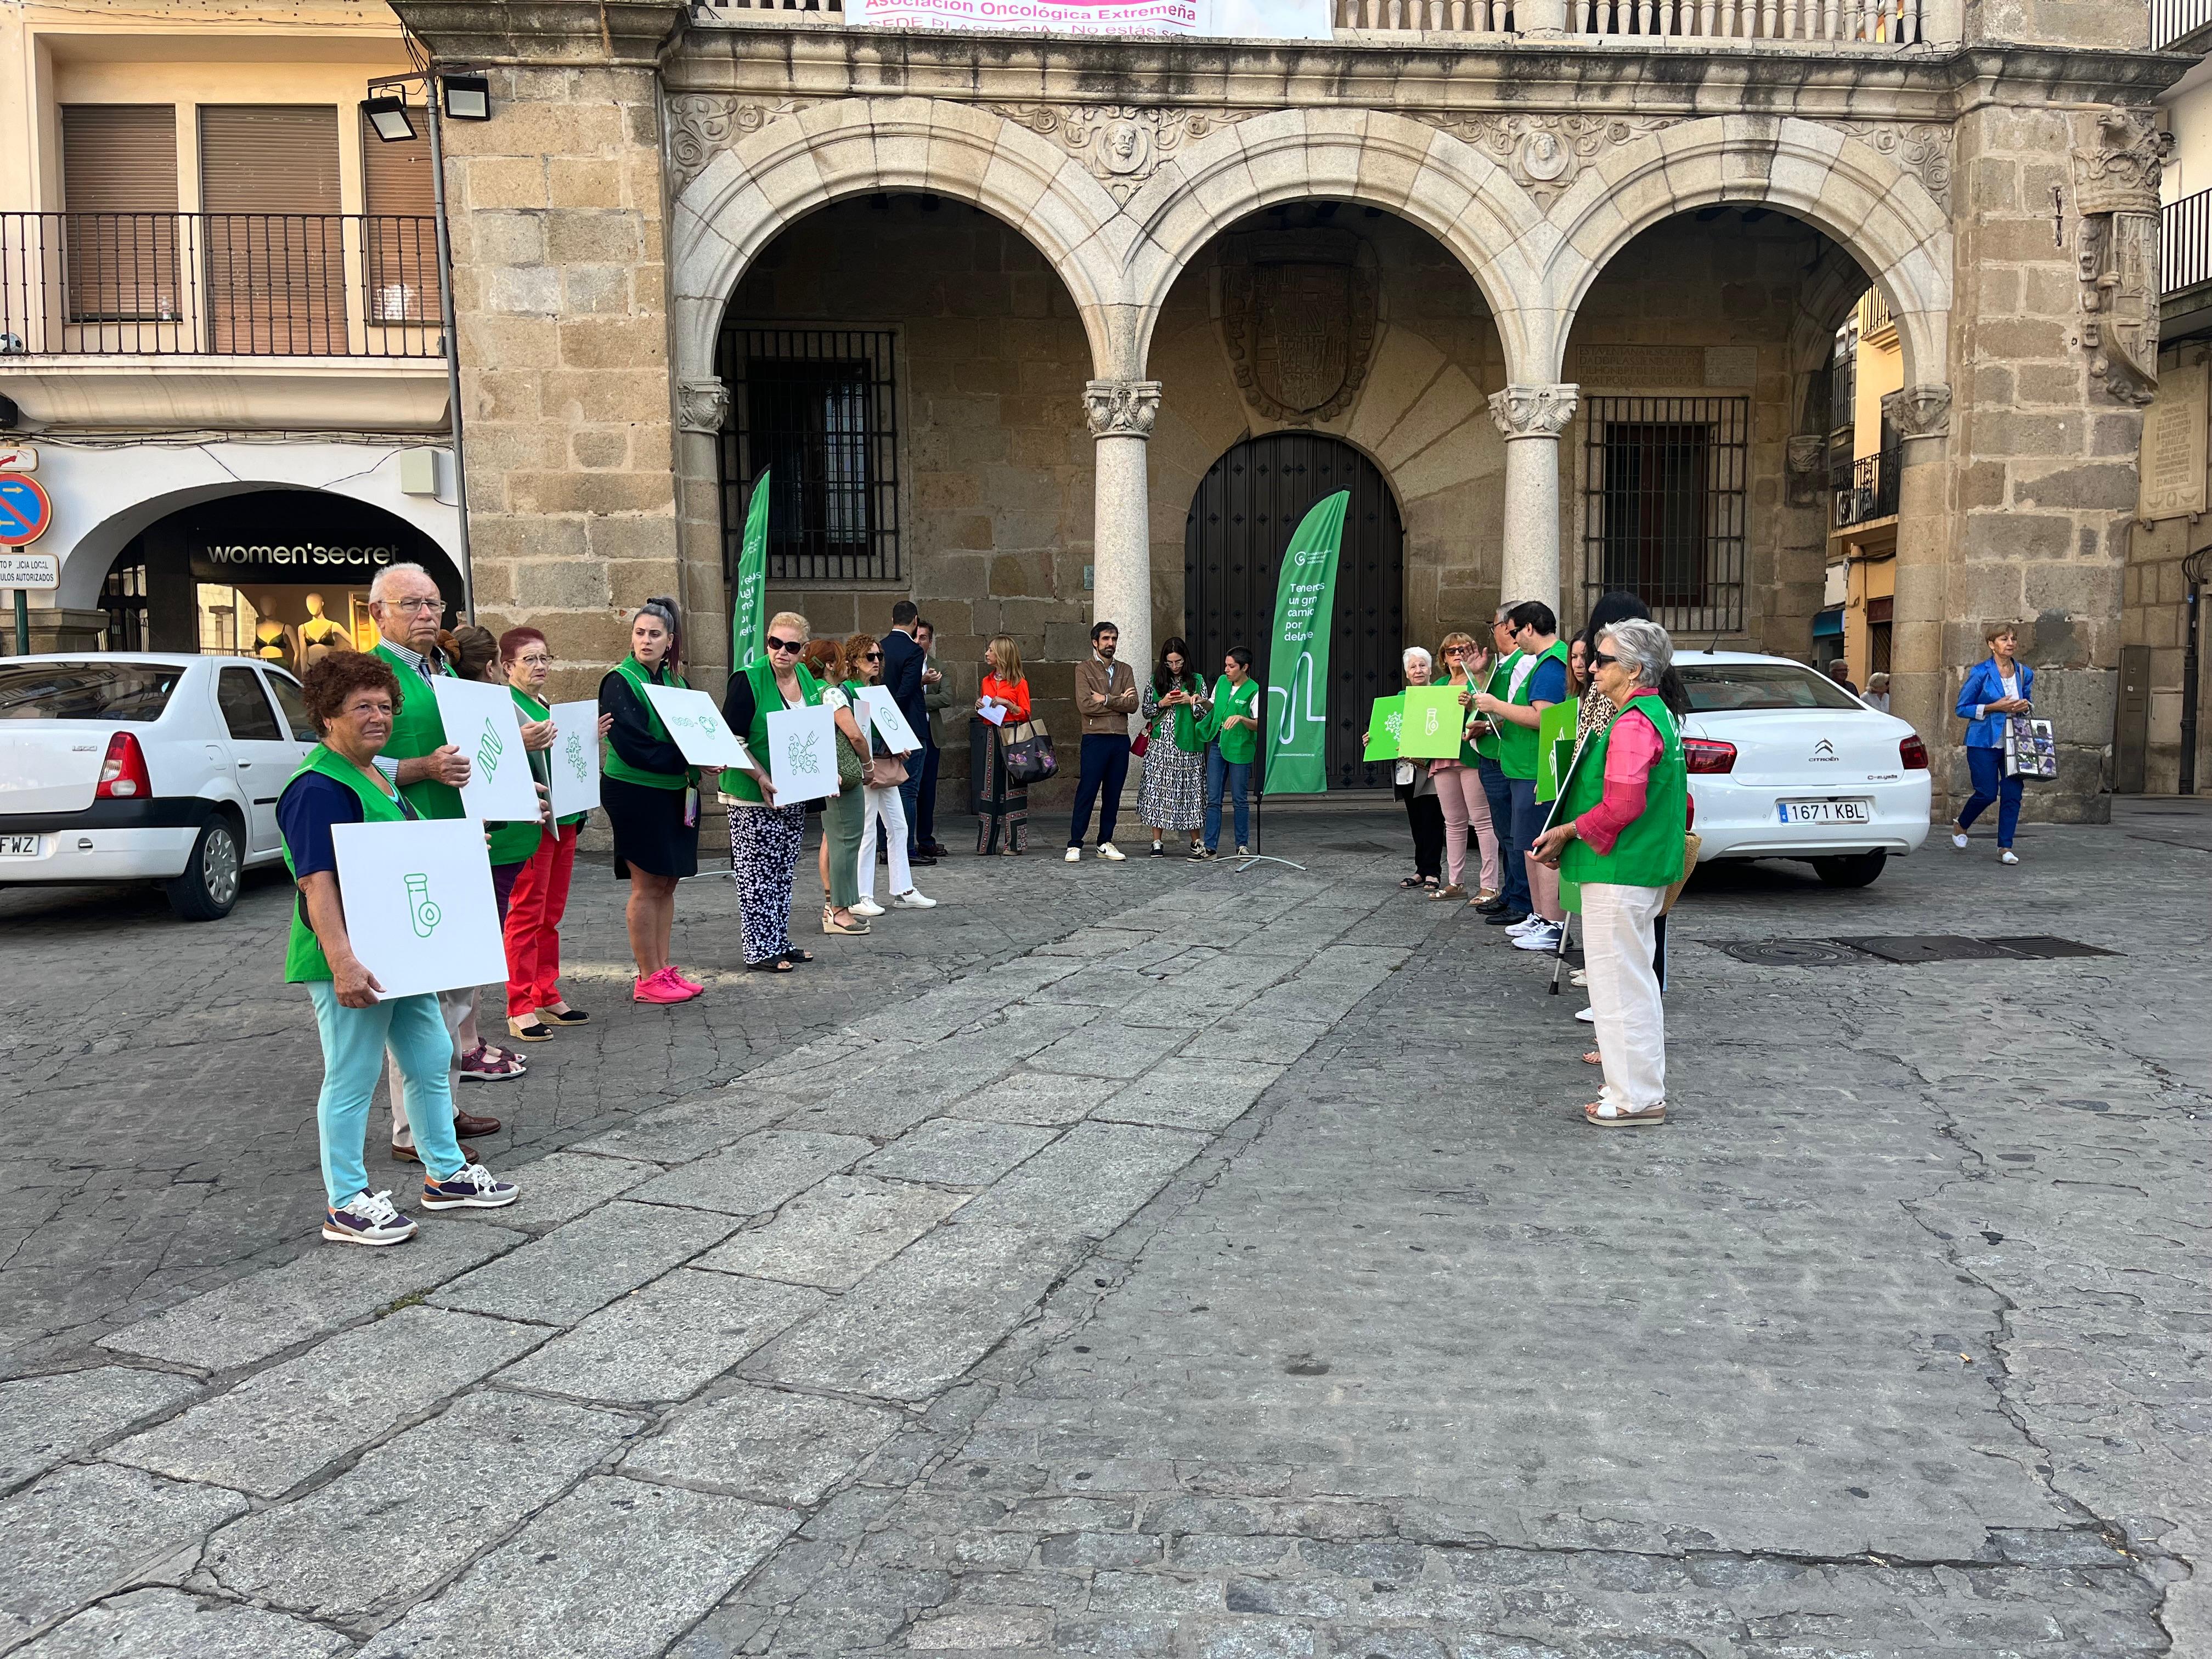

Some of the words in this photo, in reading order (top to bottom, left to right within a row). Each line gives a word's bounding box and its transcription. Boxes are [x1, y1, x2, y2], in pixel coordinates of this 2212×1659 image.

[980, 2, 1091, 20] Oncológica
[1098, 4, 1195, 21] Extremeña
[1071, 25, 1098, 35] No
[207, 543, 399, 565] women'secret
[16, 573, 54, 582] AUTORIZADOS
[1285, 621, 1302, 631] por
[1792, 804, 1829, 820] 1671
[1835, 804, 1865, 819] KBL
